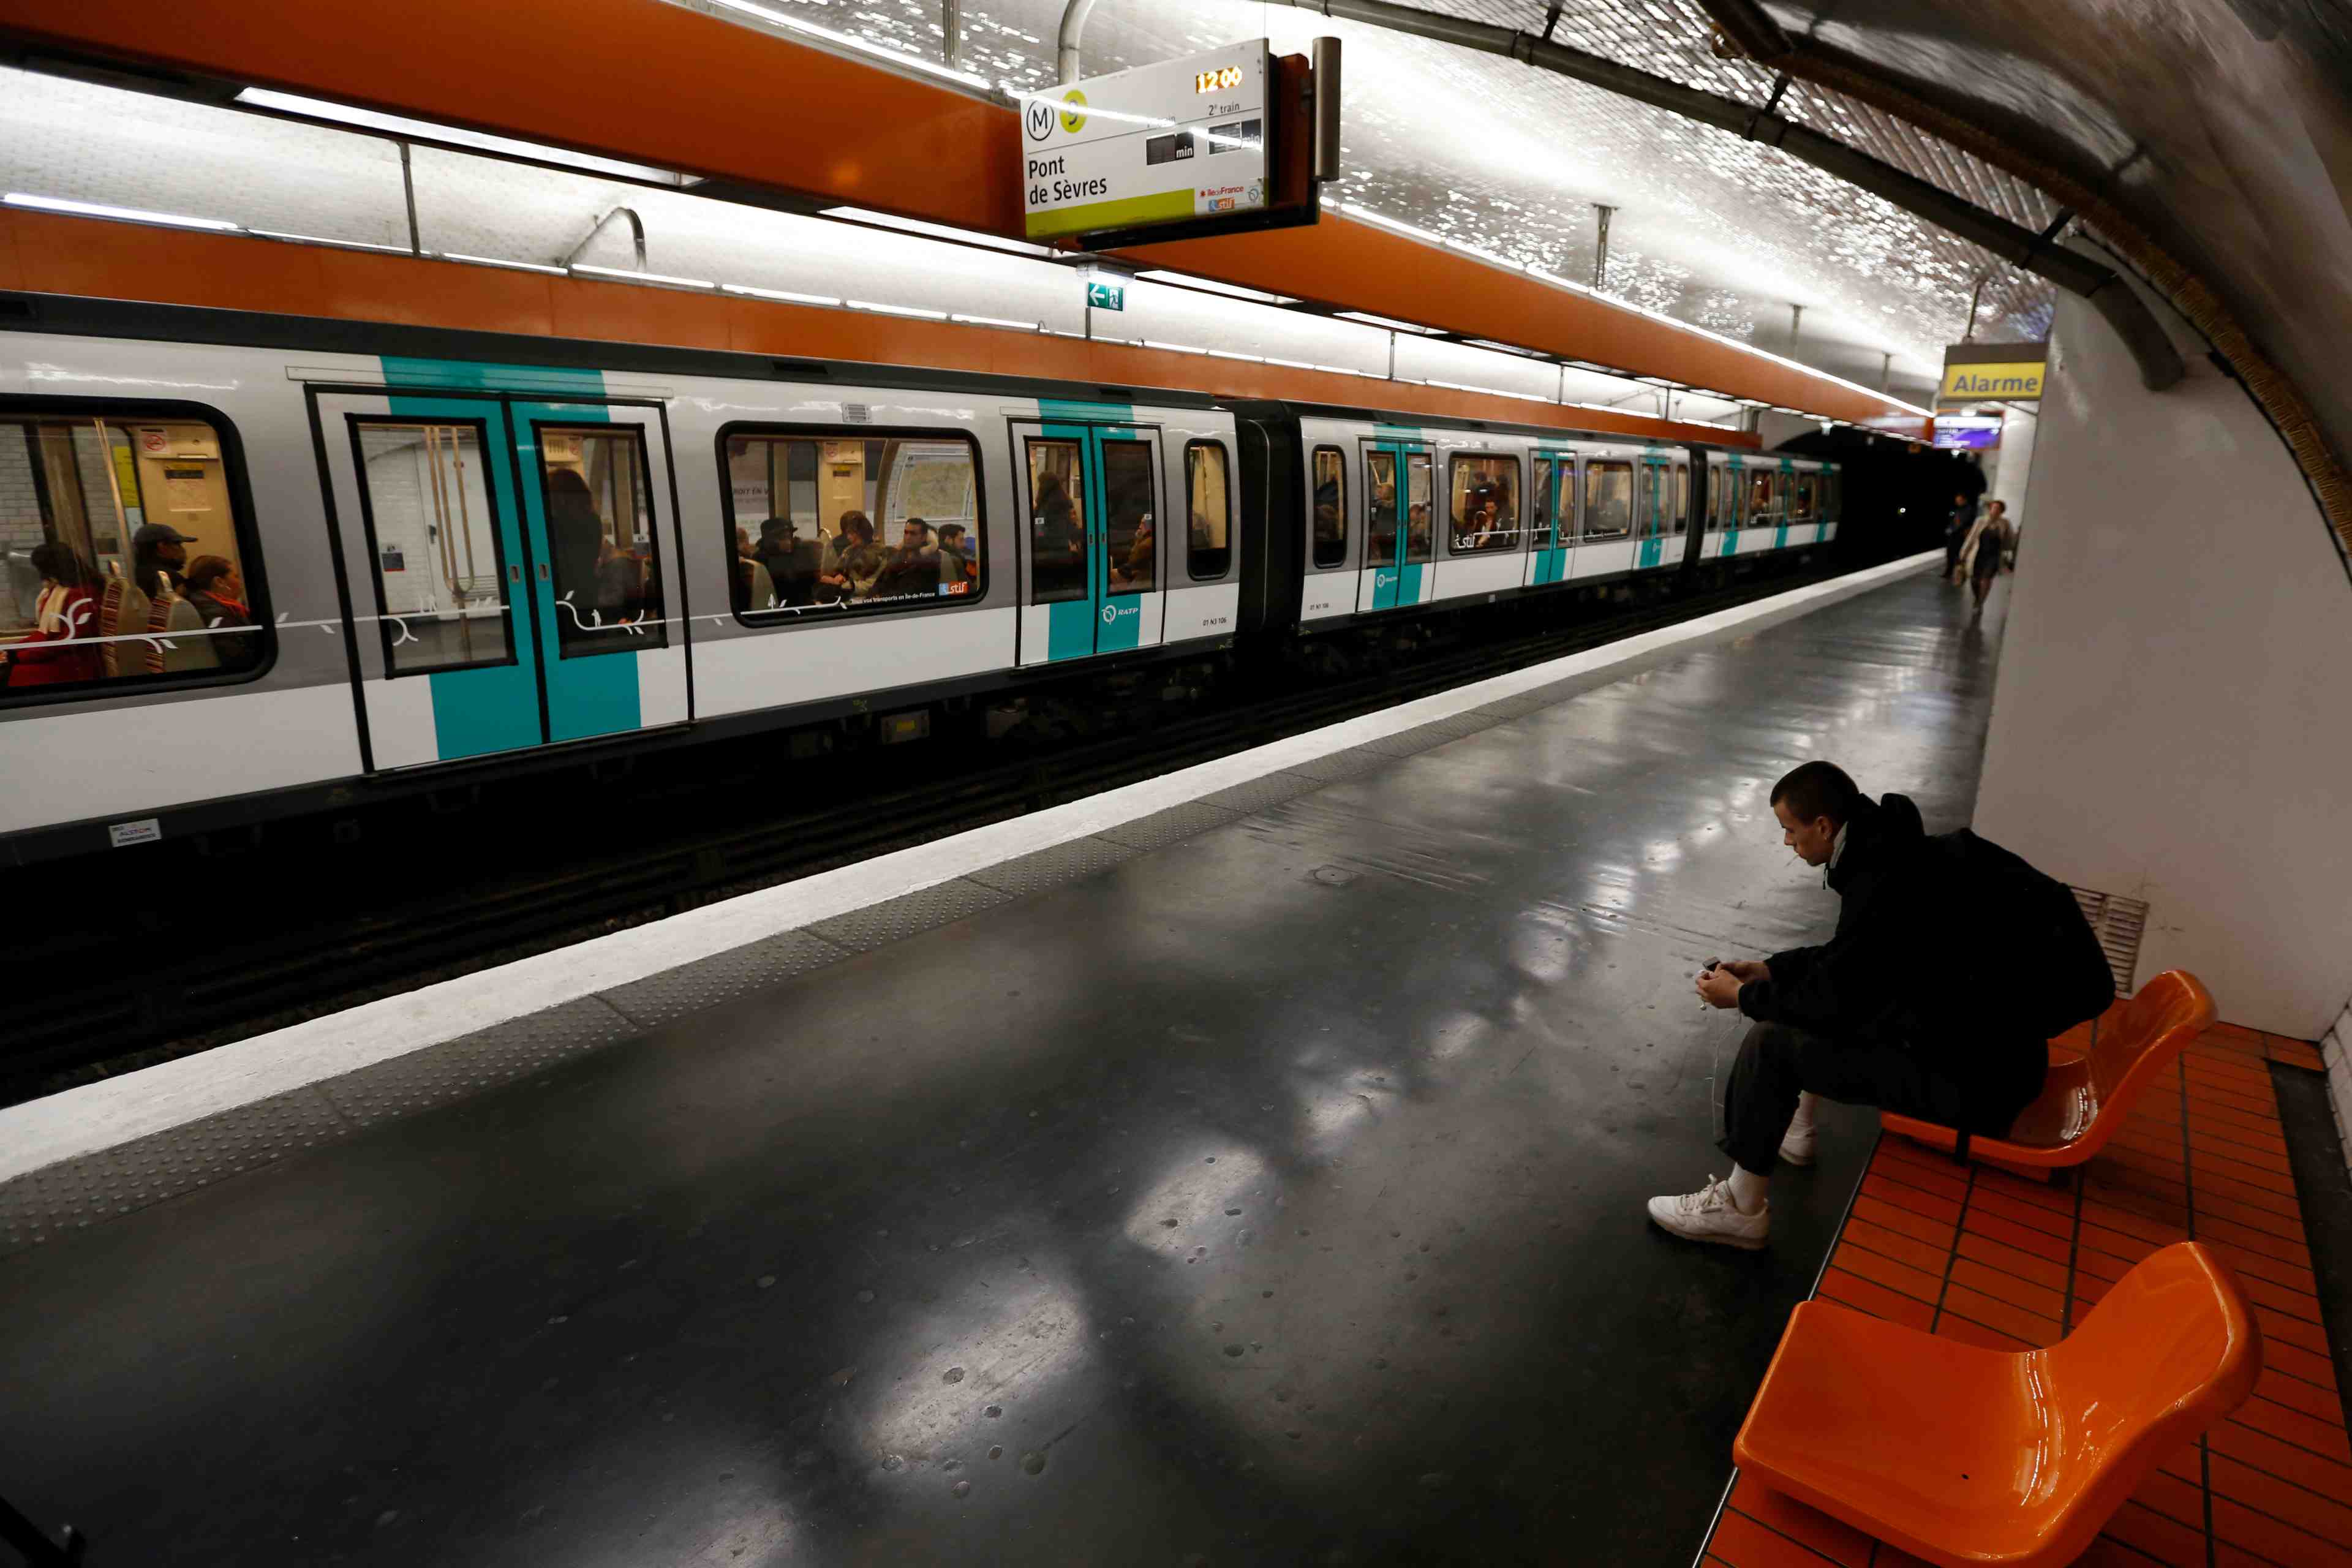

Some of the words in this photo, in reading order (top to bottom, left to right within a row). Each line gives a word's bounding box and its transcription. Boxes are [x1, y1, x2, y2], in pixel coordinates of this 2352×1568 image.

[1219, 100, 1240, 113] train
[1033, 107, 1048, 132] M
[1176, 146, 1193, 158] min
[1029, 156, 1065, 179] Pont
[1030, 184, 1048, 205] de
[1054, 178, 1107, 201] Sèvres
[1953, 374, 2039, 393] Alarme
[950, 582, 967, 594] stif
